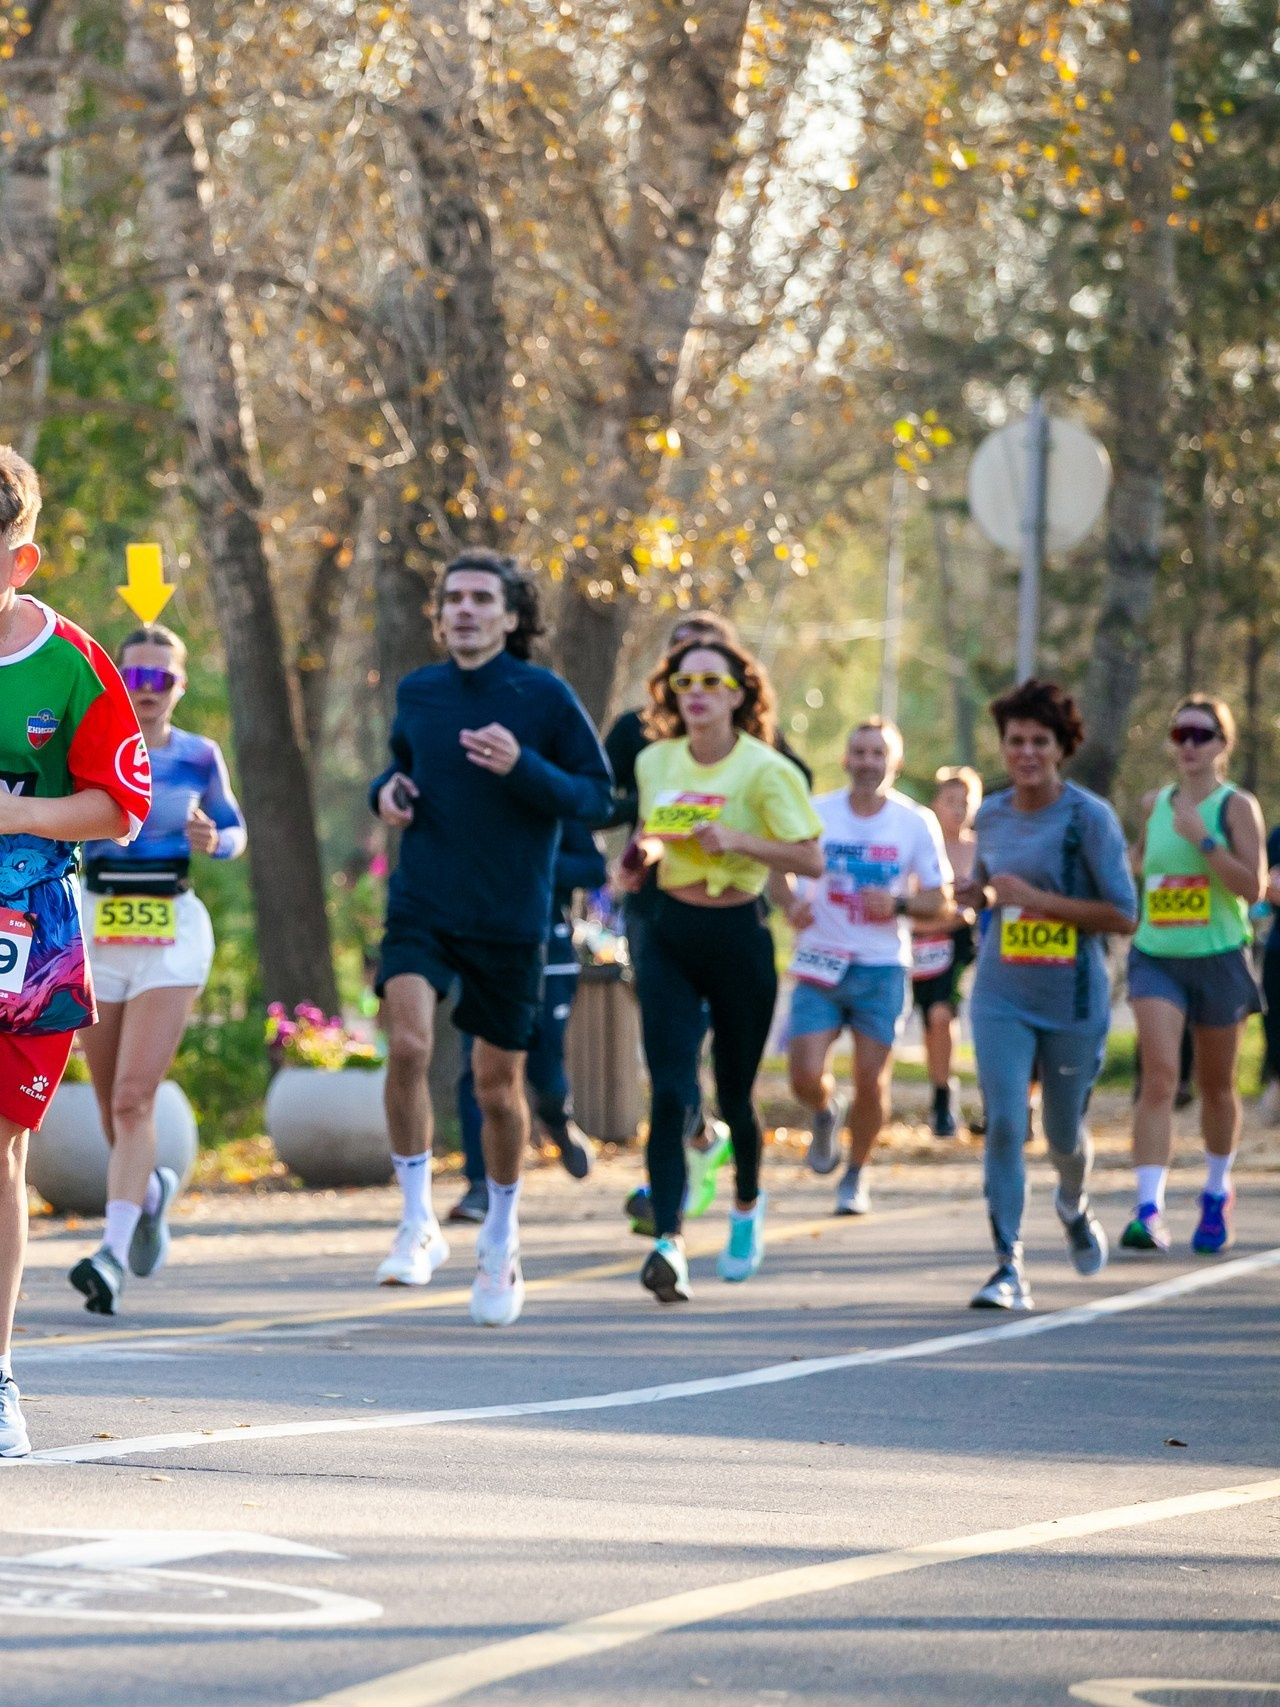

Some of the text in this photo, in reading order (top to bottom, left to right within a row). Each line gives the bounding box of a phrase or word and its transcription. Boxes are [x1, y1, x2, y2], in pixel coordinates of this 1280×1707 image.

[101, 902, 169, 926] 5353
[1006, 922, 1069, 948] 5104
[20, 1084, 47, 1102] KELME
